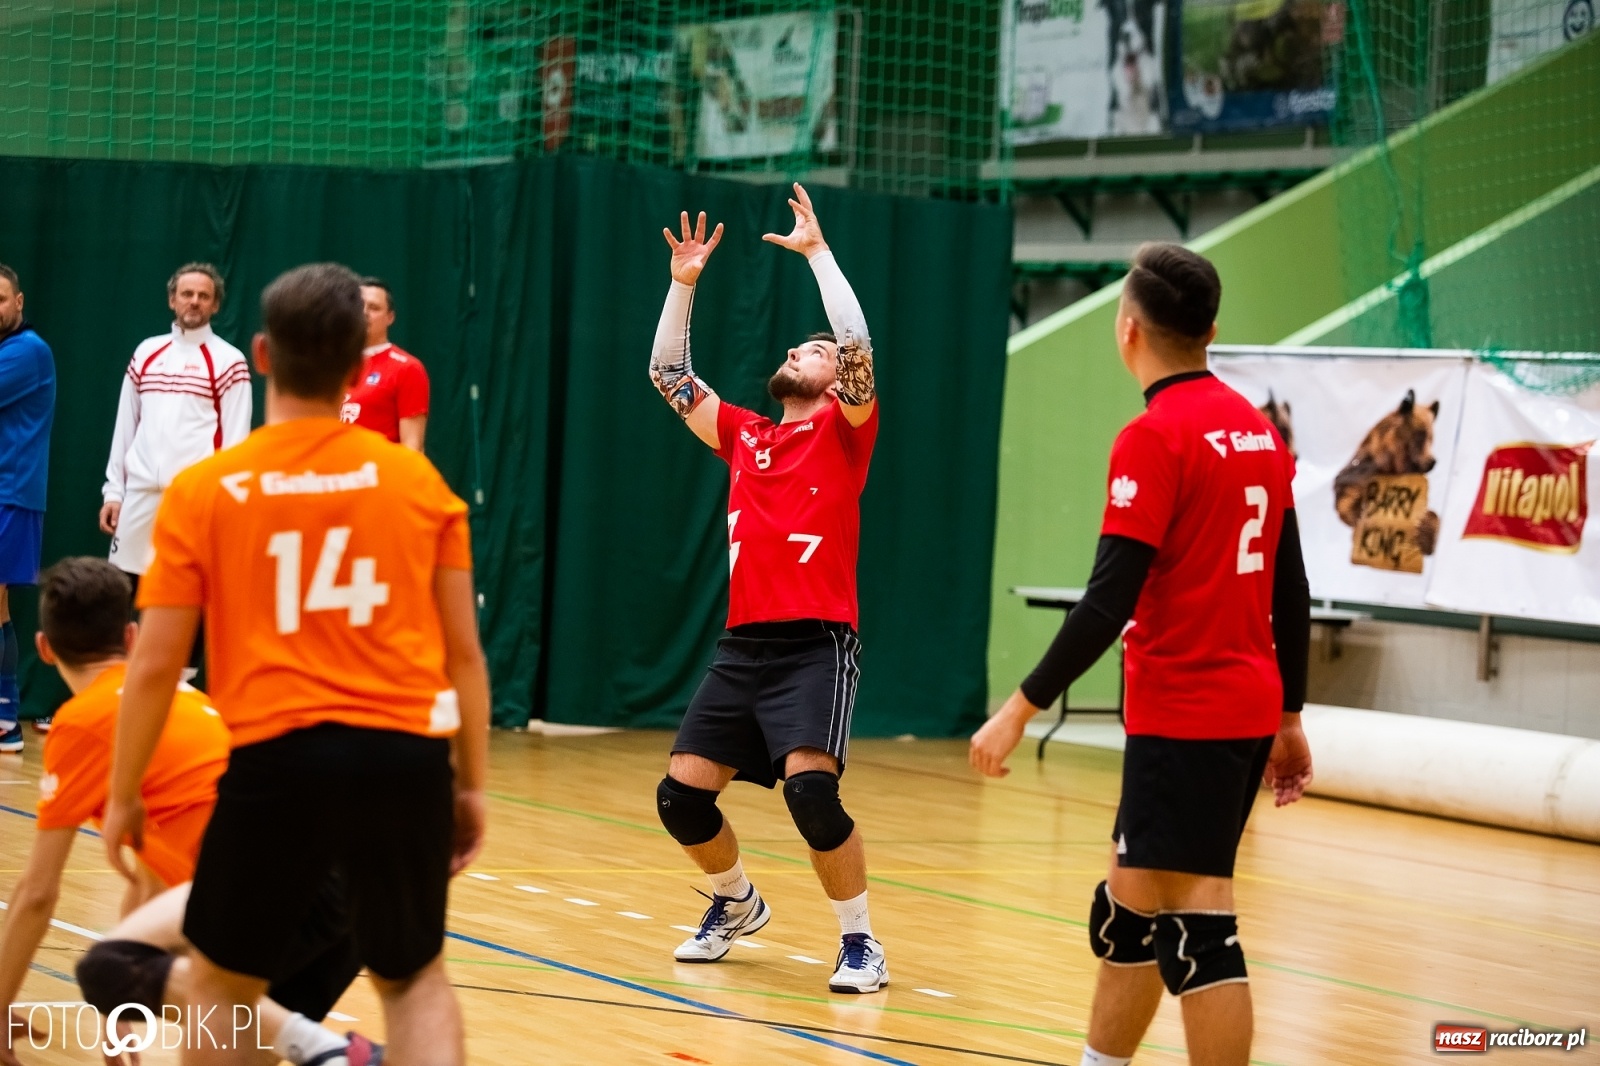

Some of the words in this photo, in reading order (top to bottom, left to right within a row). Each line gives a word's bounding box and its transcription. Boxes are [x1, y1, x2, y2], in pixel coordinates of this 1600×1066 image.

[1236, 485, 1269, 575] 2
[1364, 480, 1421, 518] BARRY
[1360, 524, 1407, 568] KING
[265, 526, 390, 636] 14
